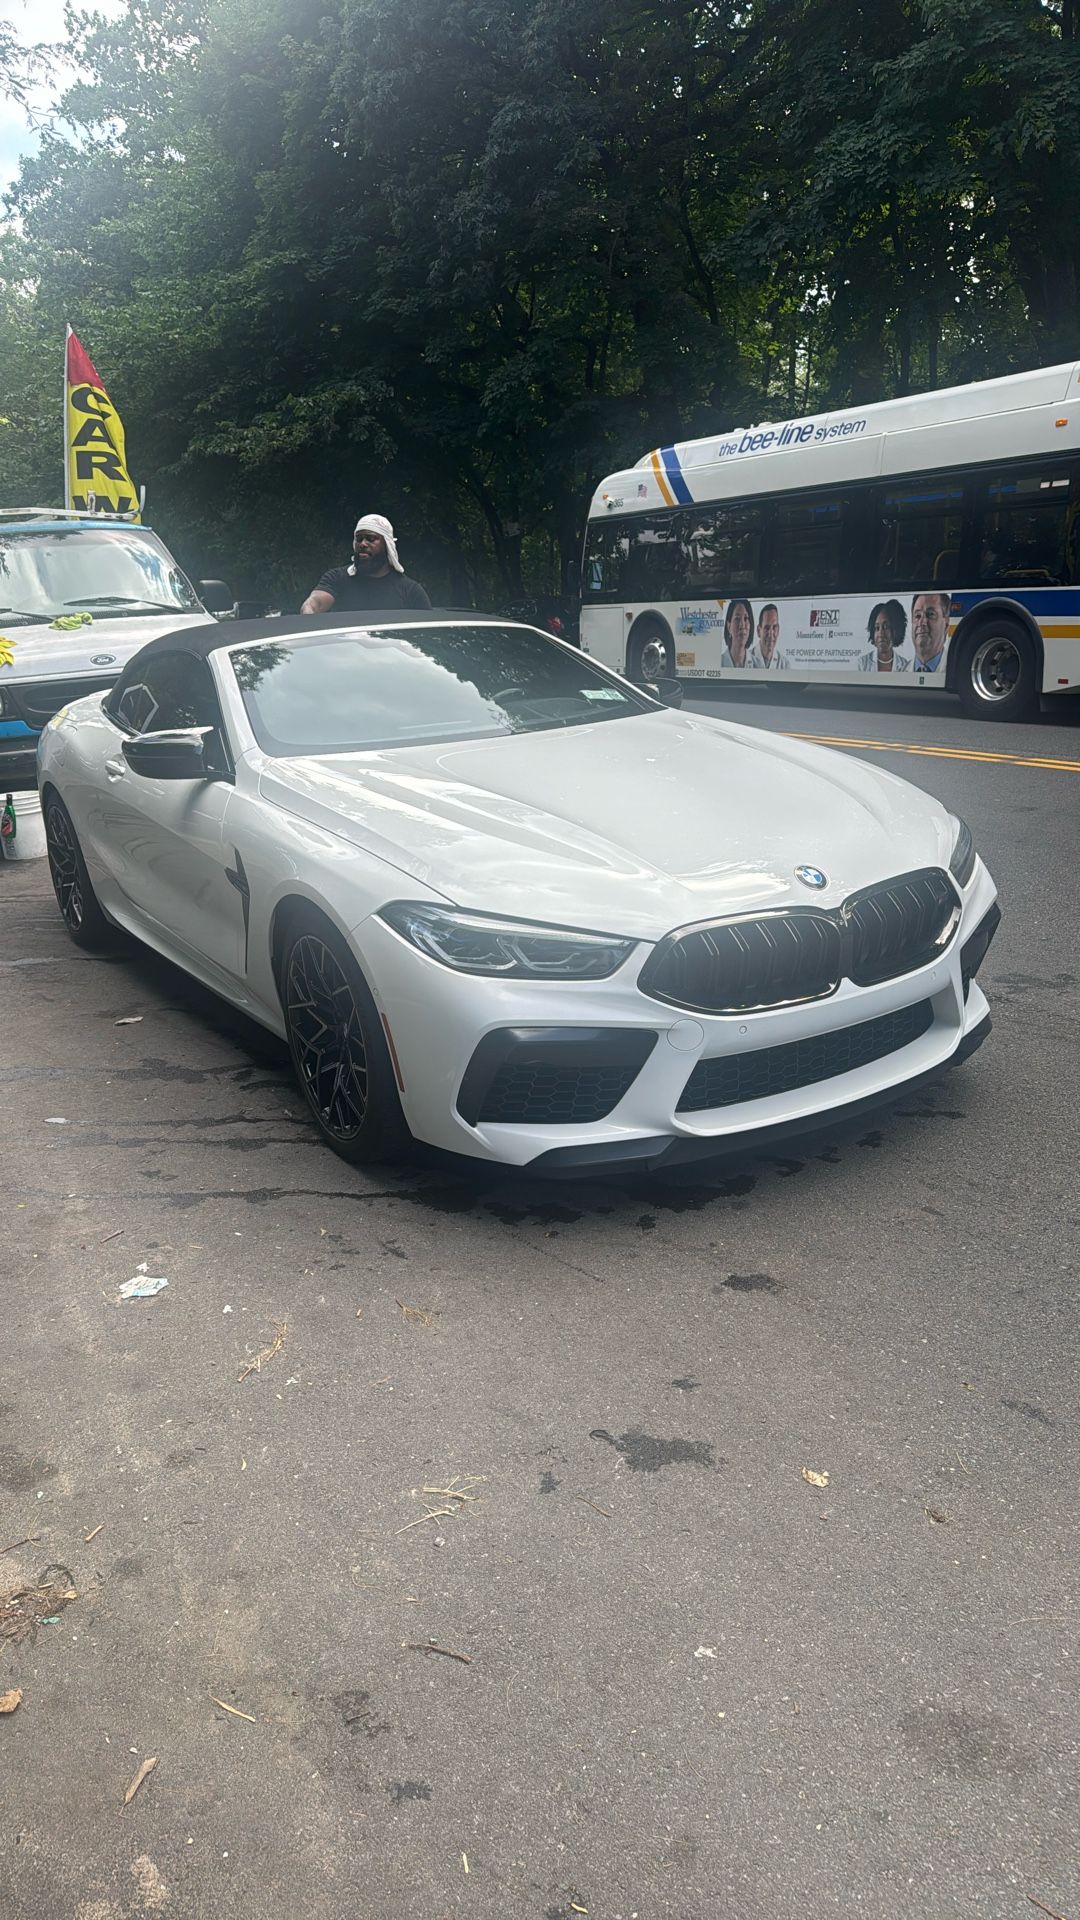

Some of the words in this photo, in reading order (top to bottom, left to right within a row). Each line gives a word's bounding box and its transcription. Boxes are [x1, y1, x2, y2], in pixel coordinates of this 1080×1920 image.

[71, 387, 127, 482] CAR
[719, 442, 738, 457] the
[737, 422, 815, 454] bee-line
[814, 419, 867, 442] system
[680, 607, 719, 621] Westchester
[785, 648, 796, 656] THE
[796, 649, 816, 657] POWER
[816, 649, 825, 657] OF
[825, 649, 862, 657] PARTNERSHIP
